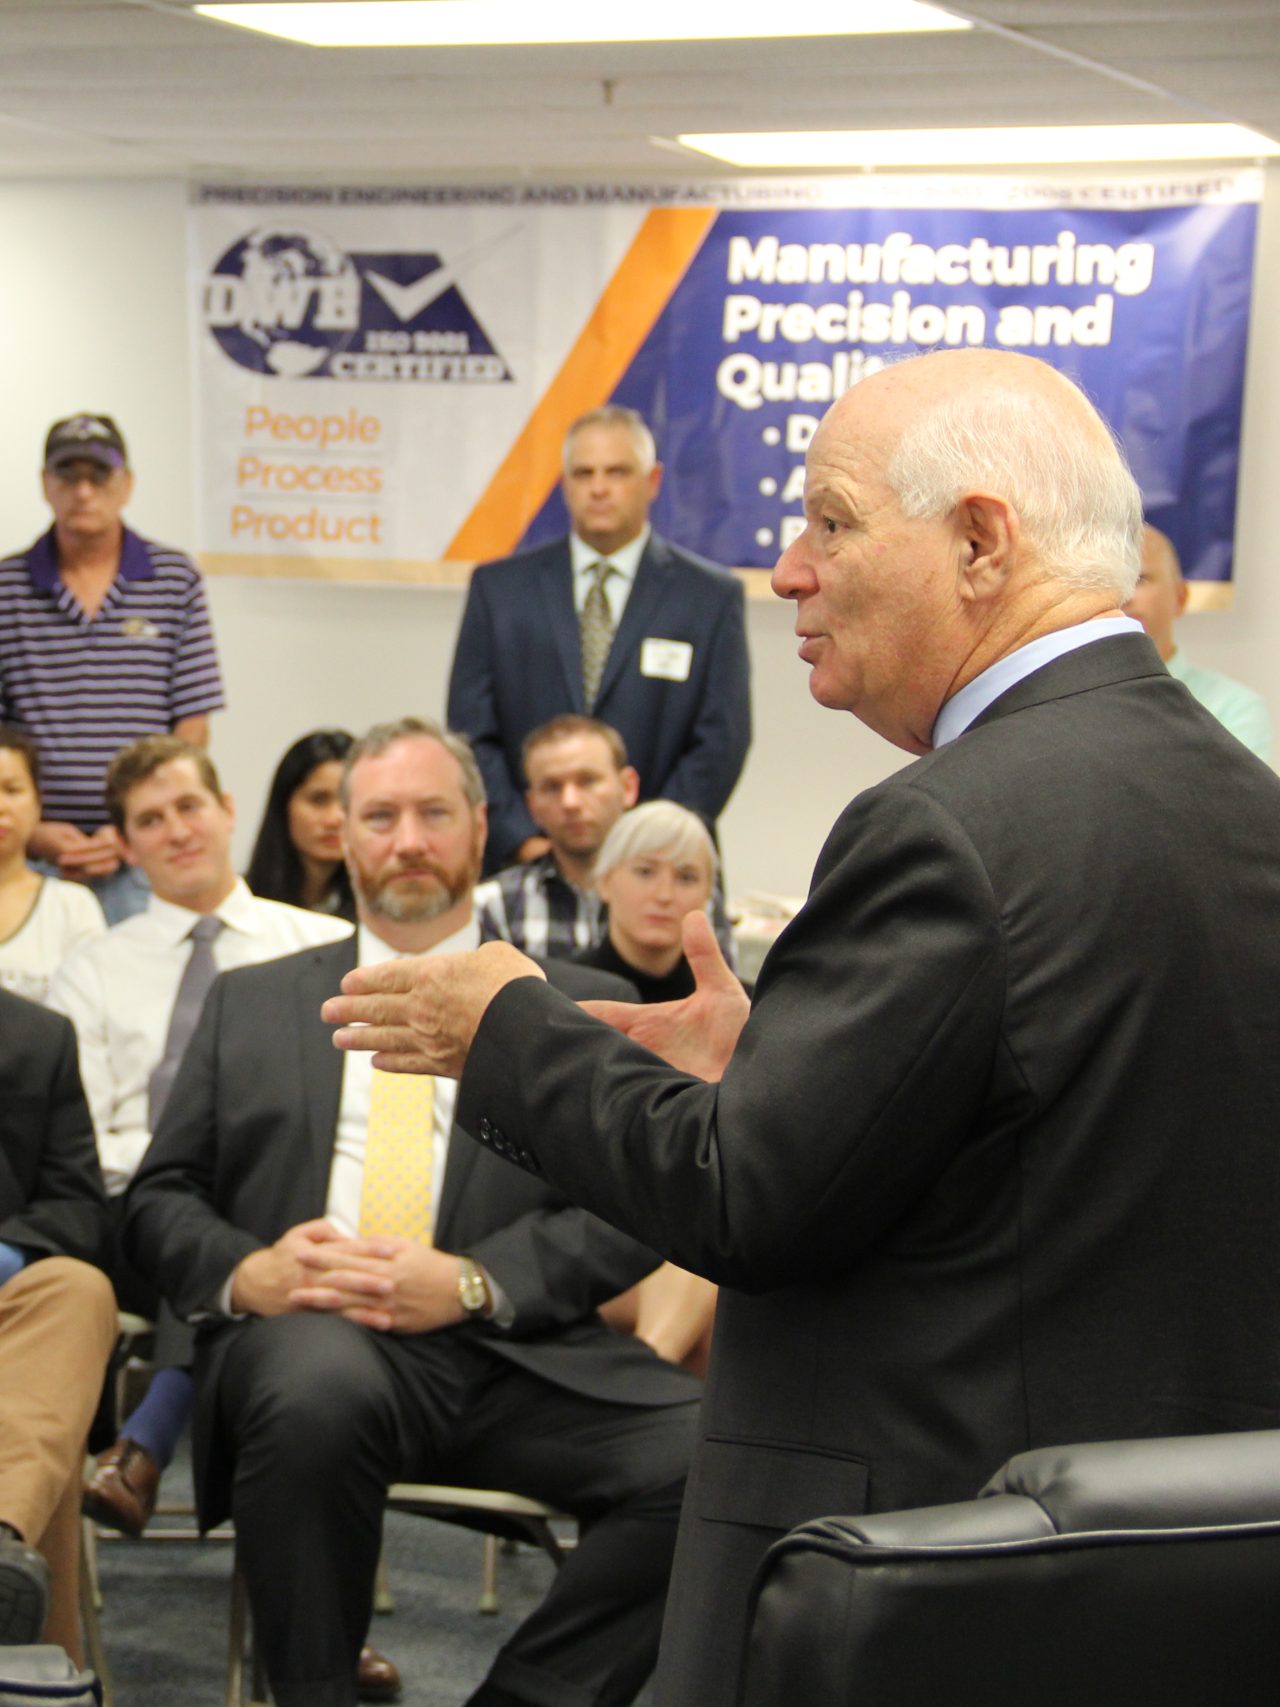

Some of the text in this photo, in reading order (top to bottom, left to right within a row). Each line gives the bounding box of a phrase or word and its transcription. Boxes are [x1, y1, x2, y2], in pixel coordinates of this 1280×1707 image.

[200, 178, 825, 206] PRECISION ENGINEERING AND MANUFACTURING
[726, 230, 1155, 296] Manufacturing
[722, 290, 1115, 347] Precision and
[328, 353, 509, 380] CERTIFIED
[717, 350, 884, 410] Quali
[243, 404, 382, 450] People
[236, 455, 384, 495] Process
[230, 503, 384, 545] Product
